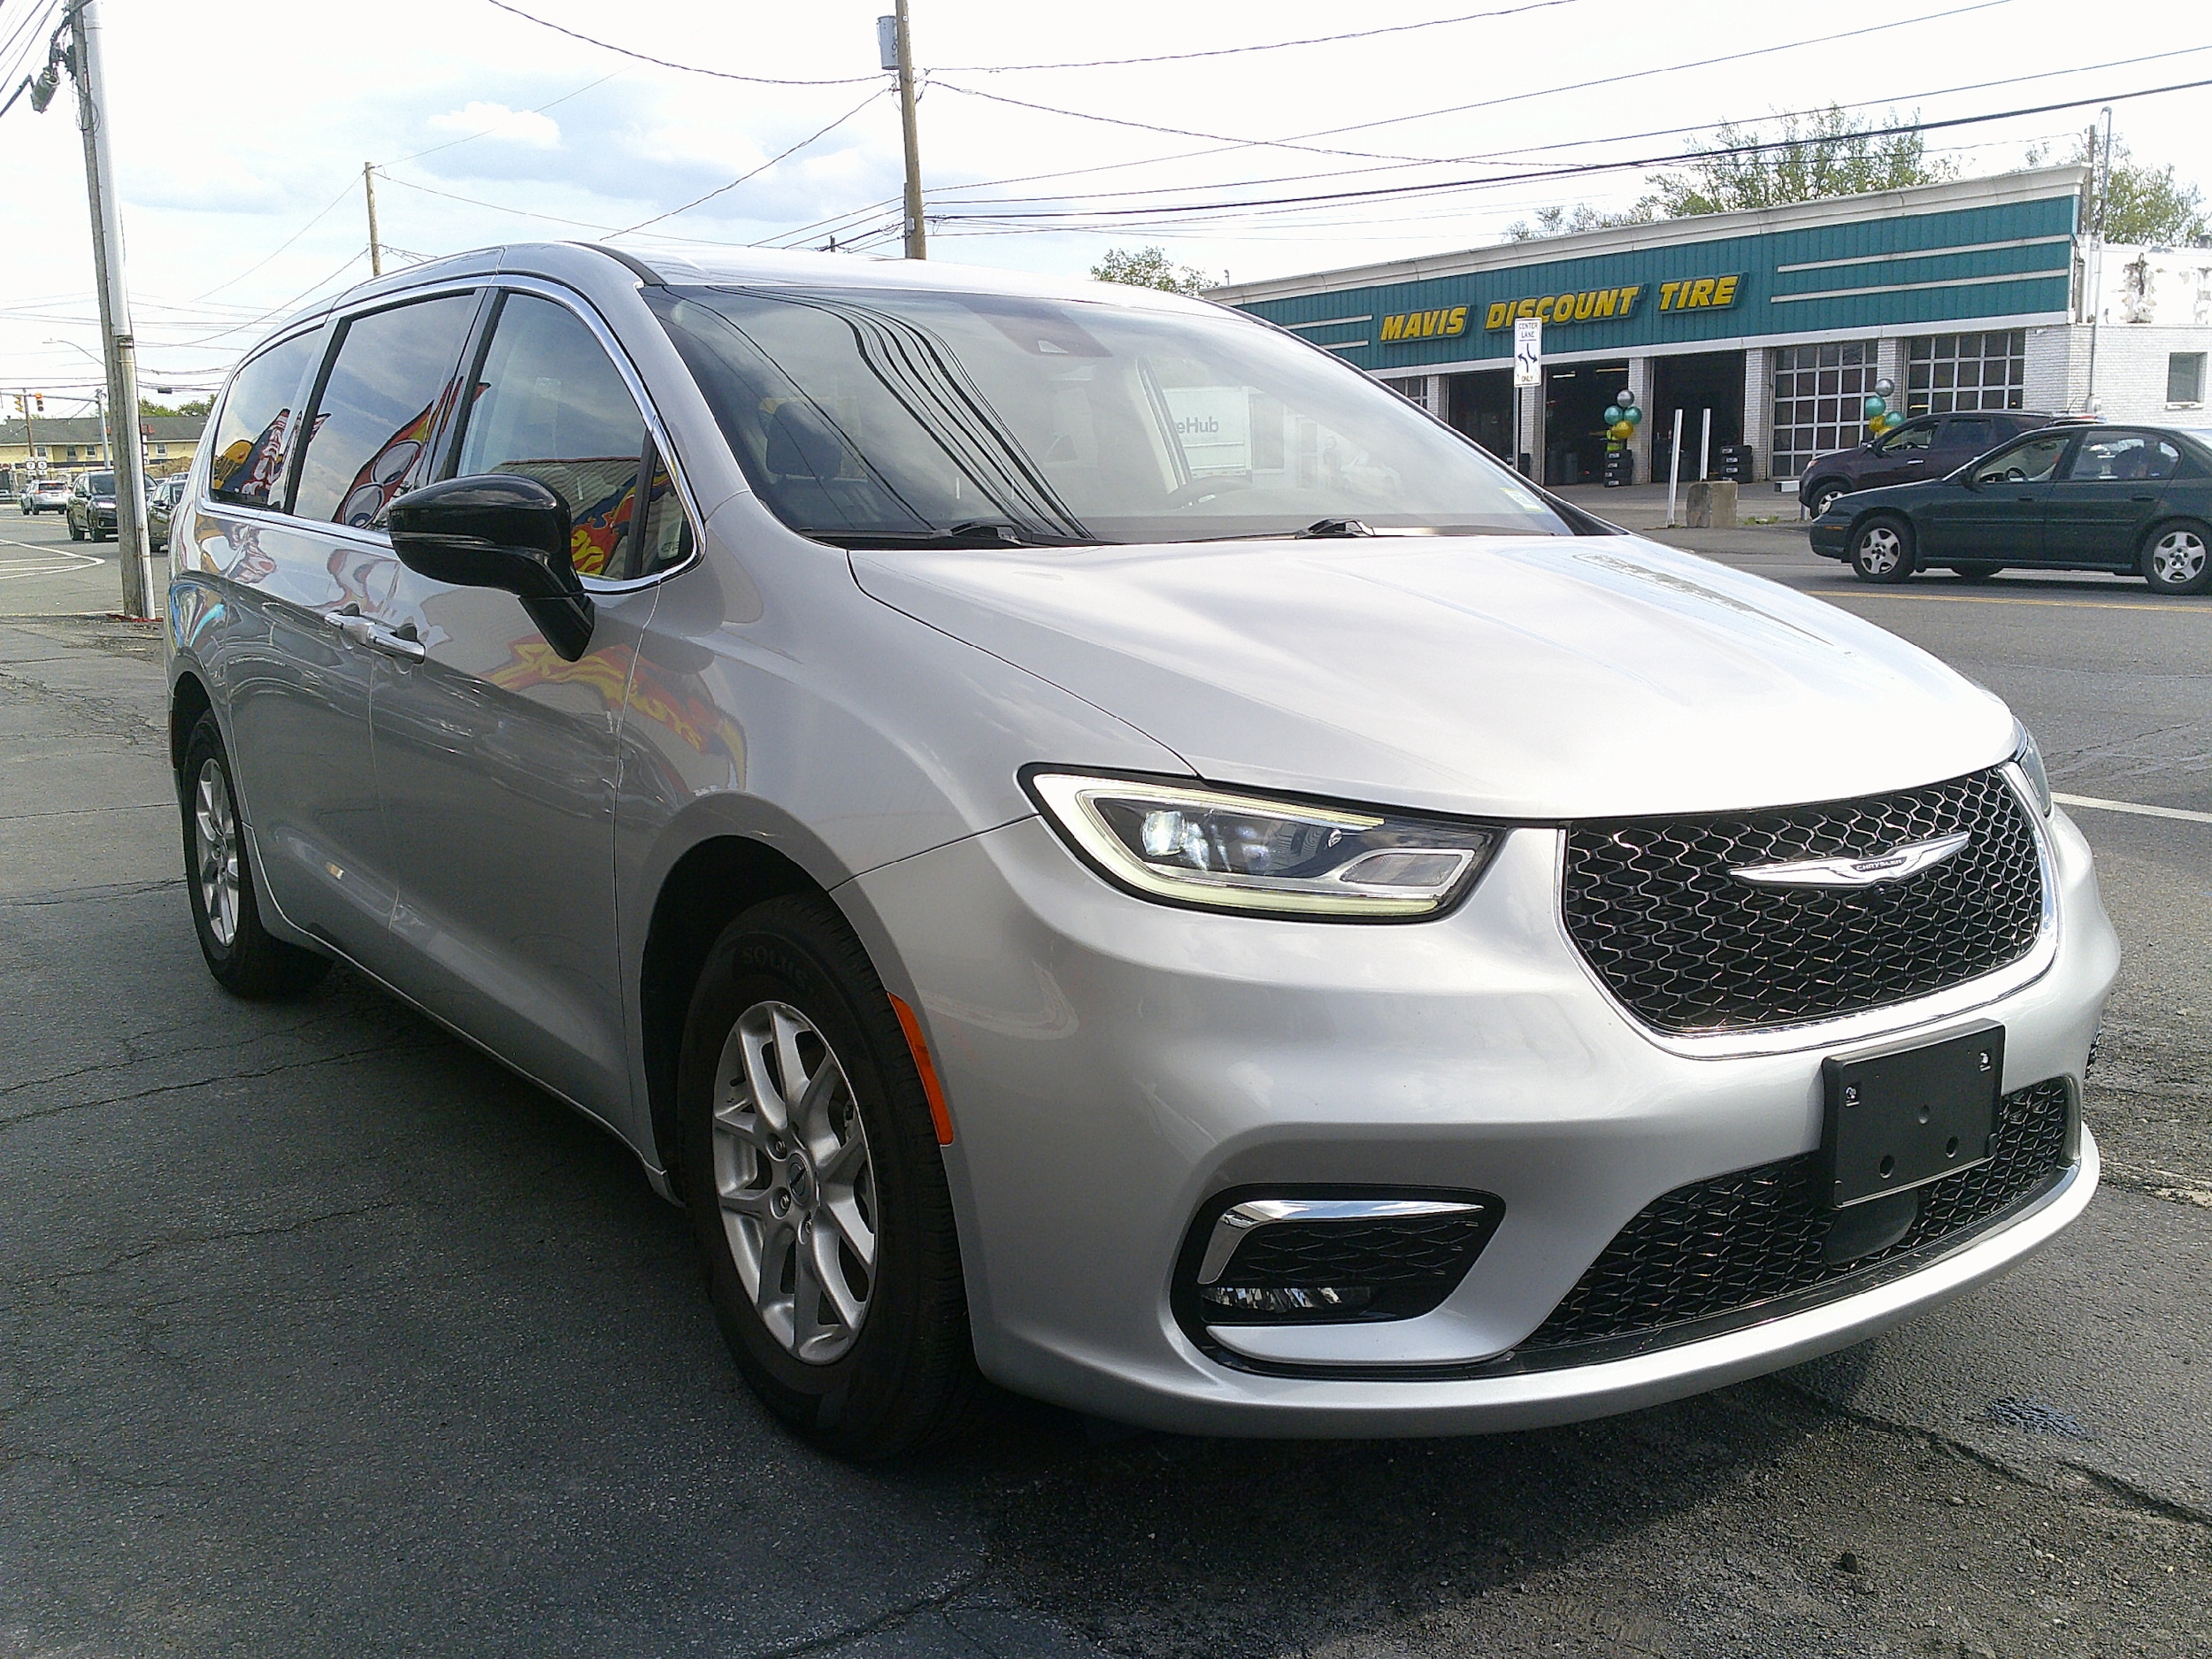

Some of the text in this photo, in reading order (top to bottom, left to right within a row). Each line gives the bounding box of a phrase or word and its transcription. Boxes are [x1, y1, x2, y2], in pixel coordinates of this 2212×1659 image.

[1380, 275, 1739, 342] MAVIS DISCOUNT TIRE
[1175, 416, 1219, 434] eHub
[1855, 858, 1903, 872] CHRYSLER
